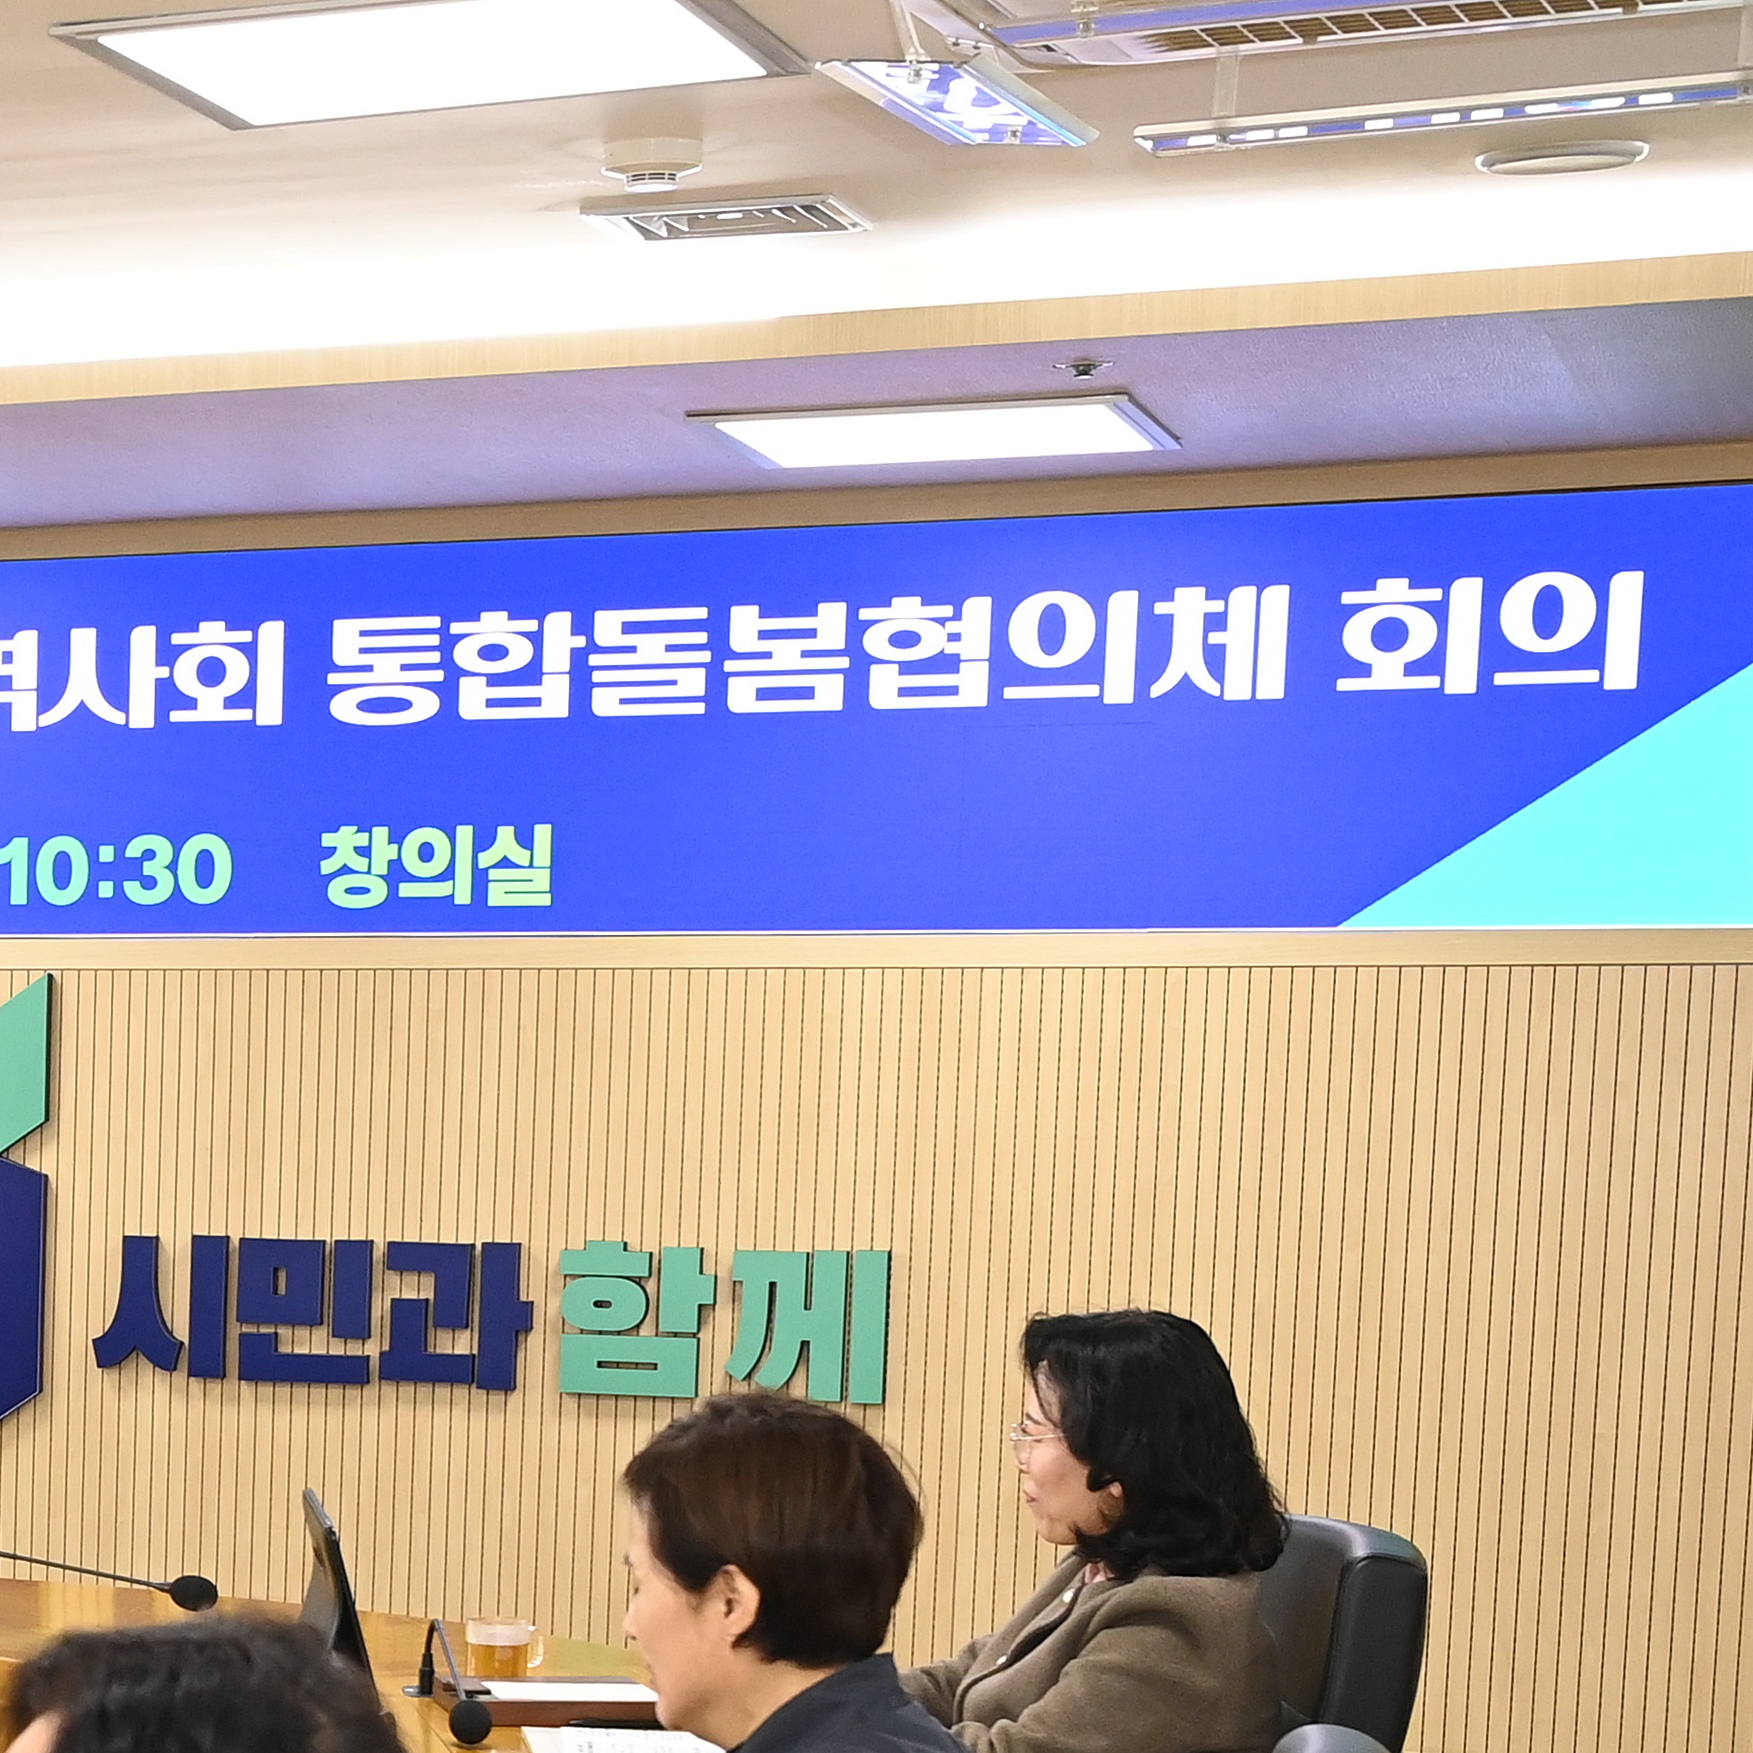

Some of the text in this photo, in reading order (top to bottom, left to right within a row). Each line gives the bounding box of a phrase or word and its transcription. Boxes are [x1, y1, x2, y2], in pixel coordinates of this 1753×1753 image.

[326, 585, 1290, 726] 통합돌봄협의체
[1335, 571, 1645, 695] 회의
[319, 823, 552, 909] 창의실
[94, 1235, 533, 1392] 시민과
[559, 1239, 890, 1405] 함께
